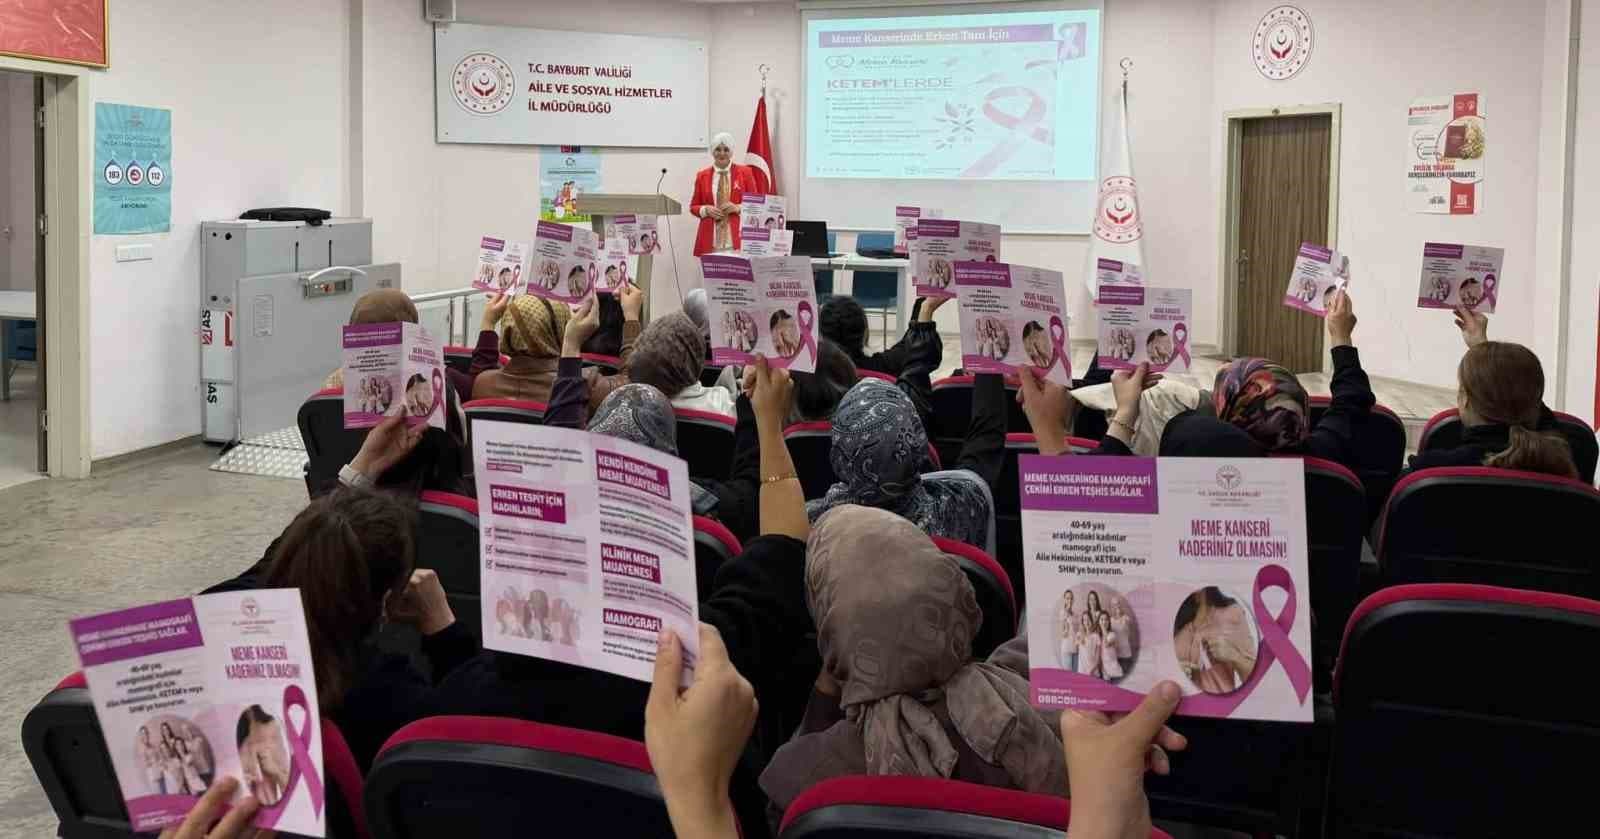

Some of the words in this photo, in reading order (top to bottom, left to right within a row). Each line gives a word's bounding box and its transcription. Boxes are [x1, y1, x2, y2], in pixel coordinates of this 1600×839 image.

[989, 27, 1009, 41] İçin
[528, 63, 545, 74] T.C.
[548, 64, 590, 76] BAYBURT
[594, 64, 632, 78] VALİLİĞİ
[528, 80, 555, 94] AİLE
[555, 83, 569, 94] VE
[572, 84, 612, 96] SOSYAL
[615, 84, 672, 98] HİZMETLER
[827, 77, 952, 89] KETEM'LERDE
[528, 98, 538, 111] İL
[540, 100, 612, 114] MÜDÜRLÜĞÜ
[151, 172, 160, 181] 112
[598, 454, 624, 470] KENDİ
[1024, 473, 1050, 482] MEME
[1051, 472, 1099, 484] KANSERİNDE
[1100, 474, 1151, 485] MAMOGRAFİ
[492, 489, 518, 500] ERKEN
[519, 491, 544, 503] TESPİT
[545, 494, 562, 507] İÇİN
[1025, 484, 1052, 496] ÇEKİMİ
[1054, 486, 1080, 496] ERKEN
[1110, 486, 1144, 497] SAĞLAR.
[1070, 521, 1091, 530] 40-69
[1191, 520, 1222, 537] MEME
[1224, 517, 1270, 537] KANSERİ
[1096, 532, 1127, 541] kadınlar
[1062, 544, 1100, 553] mamografi
[1102, 544, 1116, 553] için
[1179, 538, 1234, 557] KADERİNİZ
[1236, 540, 1287, 558] OLMASIN!
[602, 546, 633, 563] KLİNİK
[634, 553, 658, 568] MEME
[1036, 552, 1050, 561] Aile
[1094, 555, 1127, 564] KETEM'e
[1128, 558, 1146, 566] veya
[603, 560, 654, 579] MUAYENESİ
[1058, 565, 1086, 575] SHM'ye
[605, 611, 660, 630] MAMOGRAFİ
[231, 646, 255, 660] MEME
[256, 643, 288, 660] KANSERİ
[225, 662, 266, 680] KADERİNİZ
